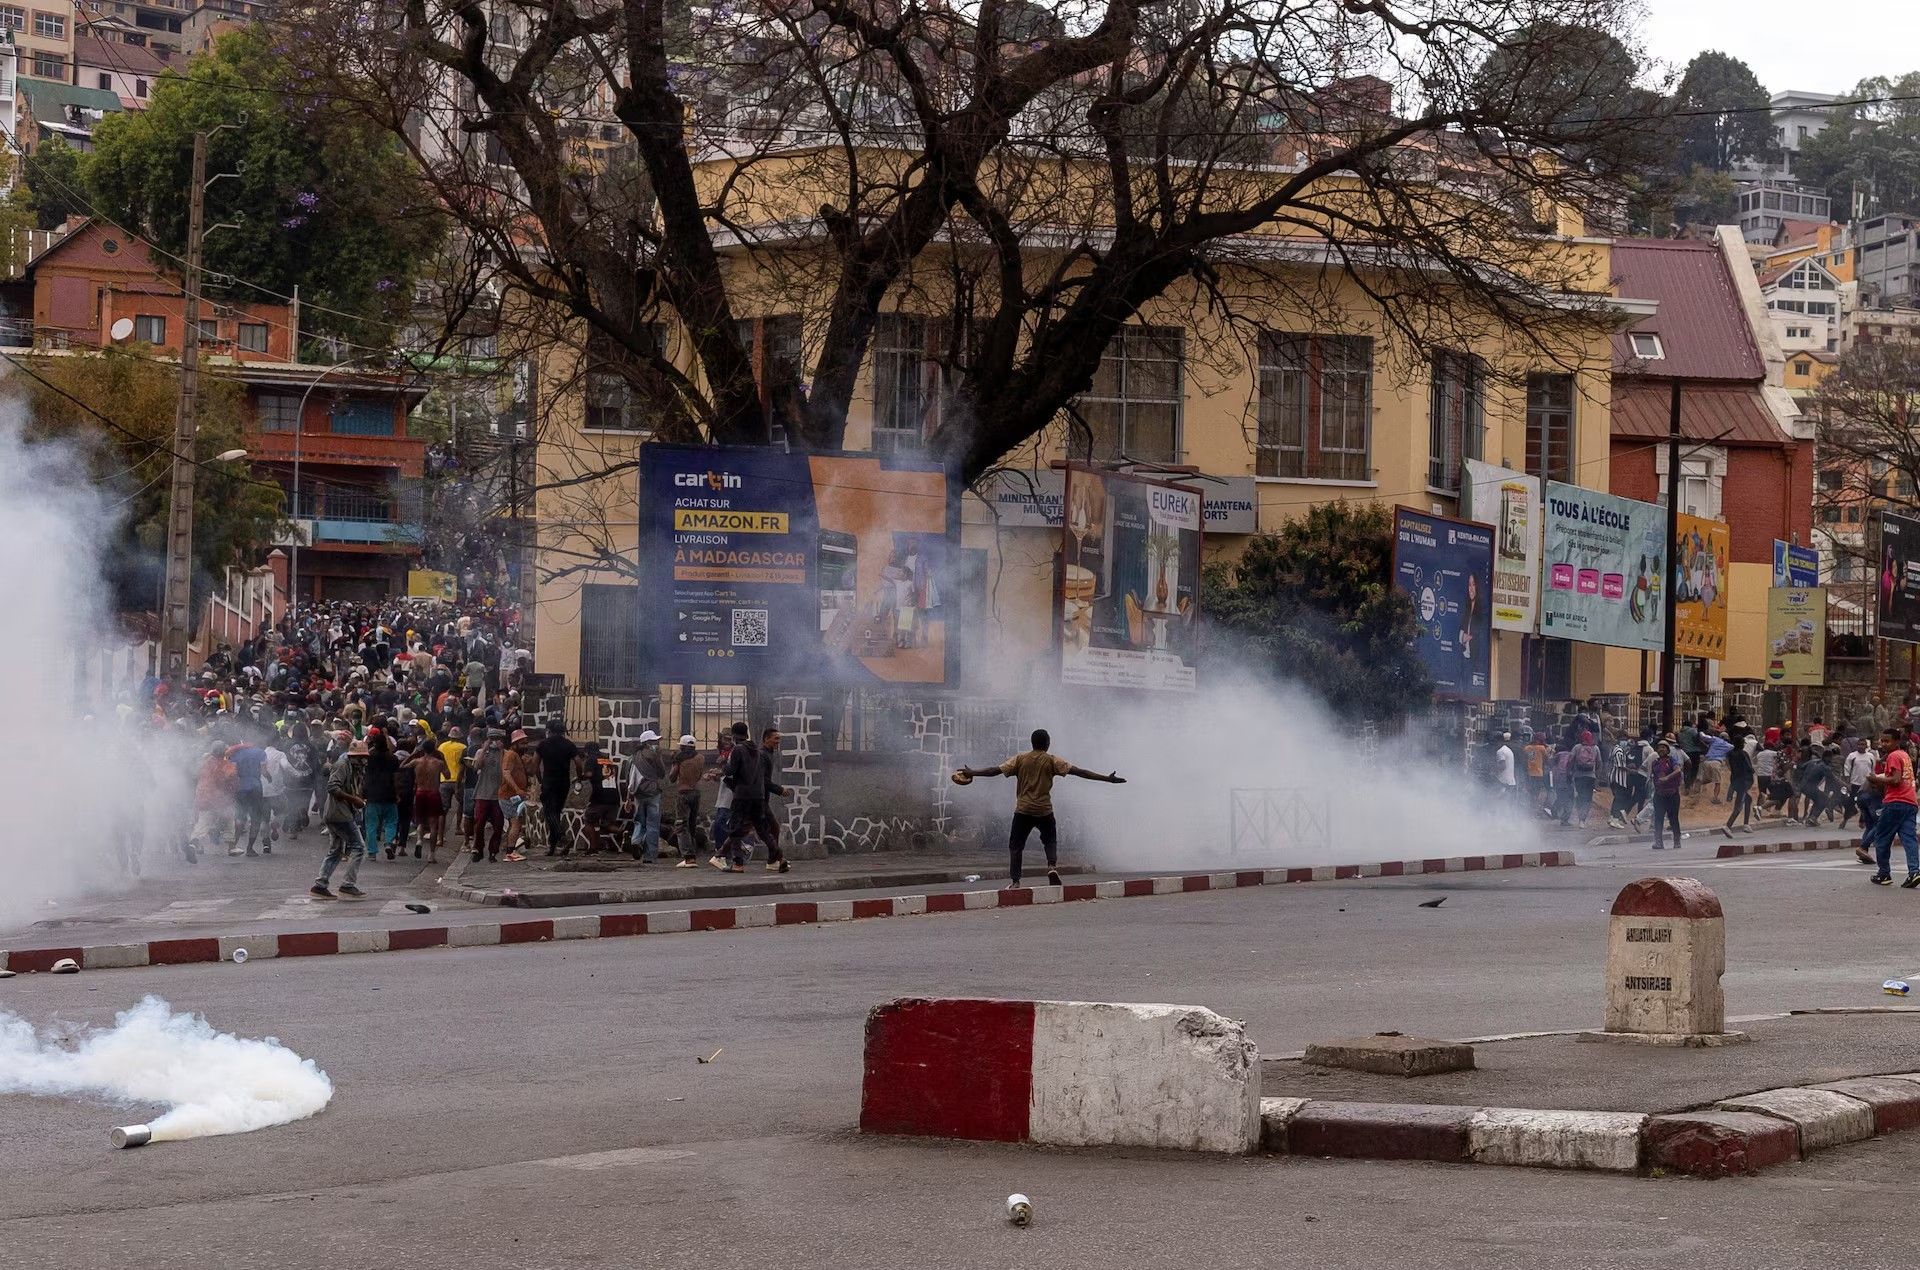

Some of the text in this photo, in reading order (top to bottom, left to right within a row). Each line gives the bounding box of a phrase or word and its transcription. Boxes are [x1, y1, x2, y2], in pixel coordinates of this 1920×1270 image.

[674, 497, 730, 509] ACHAT SUR
[681, 513, 780, 530] AMAZON.FR
[1550, 499, 1579, 519] TOUS
[1581, 501, 1590, 522] À
[1592, 506, 1629, 530] L'ÉCOLE
[1400, 519, 1432, 534] CAPITALISEZ
[674, 535, 728, 544] LIVRAISON
[1399, 531, 1437, 547] SUR L'HUMAIN
[675, 546, 805, 566] À MADAGASCAR
[1625, 976, 1672, 991] ANTSIRABE
